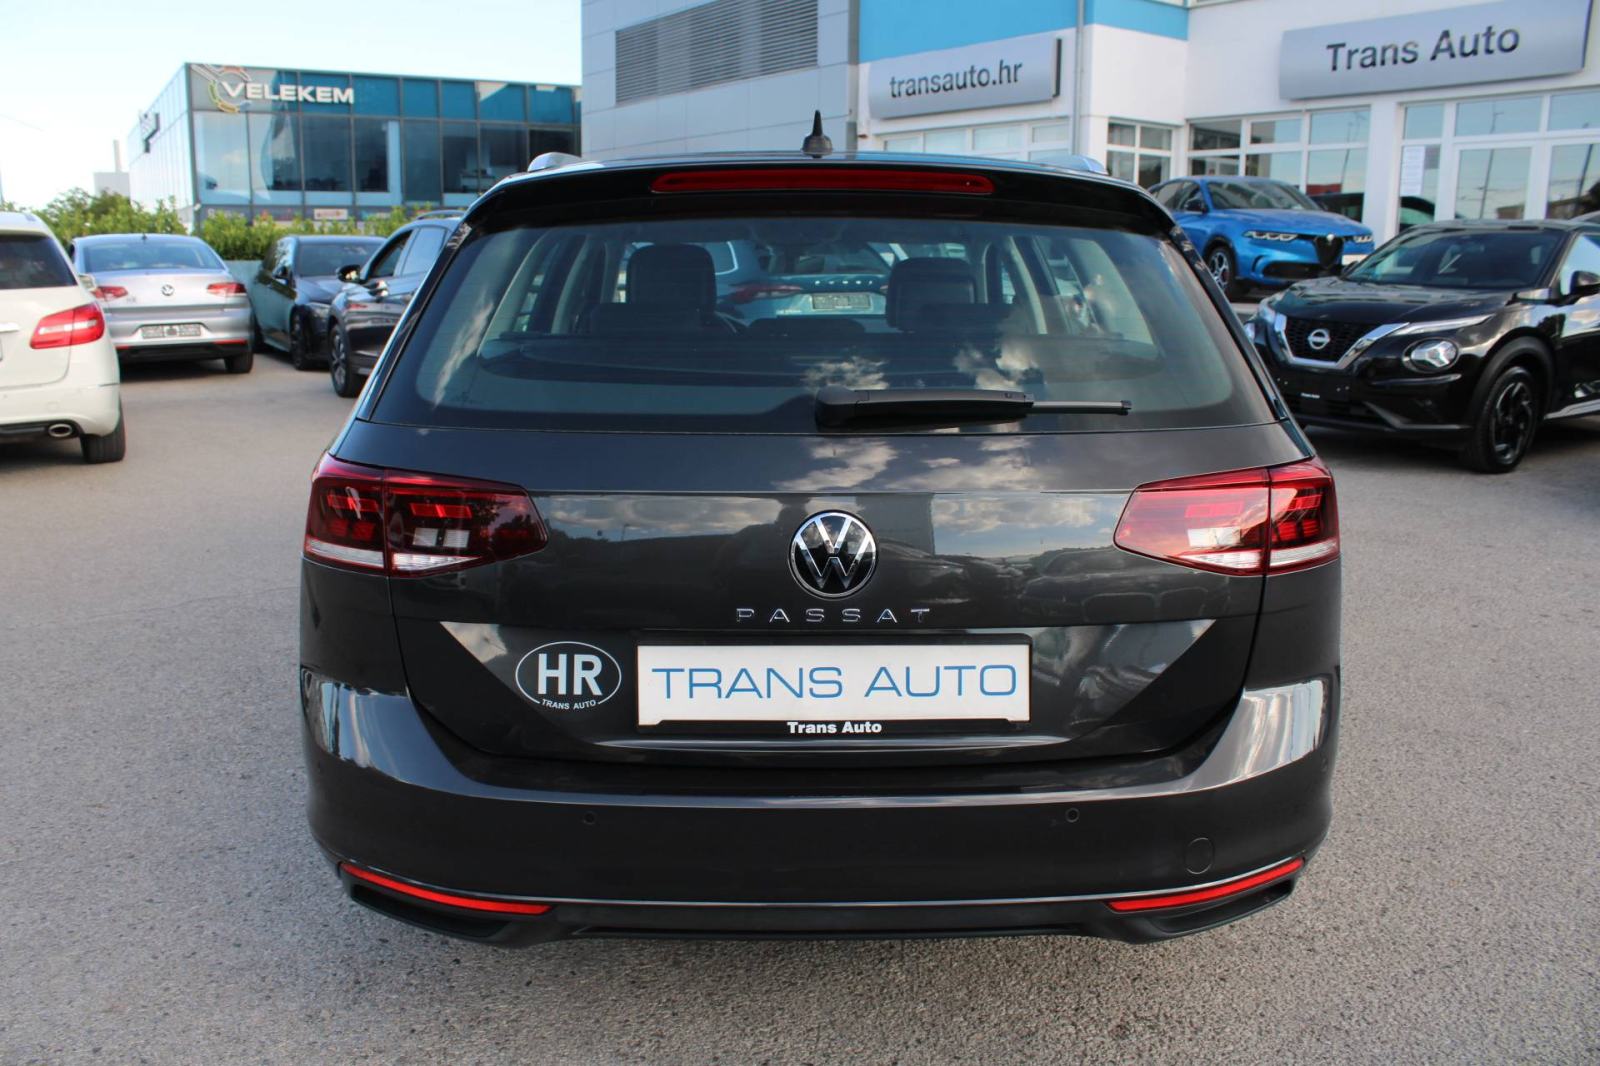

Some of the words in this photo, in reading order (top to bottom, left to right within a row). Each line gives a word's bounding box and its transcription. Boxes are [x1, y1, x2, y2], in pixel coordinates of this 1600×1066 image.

[1326, 41, 1419, 72] Trans
[1430, 25, 1520, 62] Auto
[221, 81, 355, 105] VELEKEM
[889, 59, 1023, 98] transauto.hr
[736, 607, 930, 623] PASSAT
[537, 653, 603, 696] HR
[651, 667, 844, 699] TRANS
[864, 664, 1017, 698] AUTO
[541, 698, 570, 710] TRANS
[573, 699, 597, 710] AUTO
[787, 721, 837, 734] Trans
[841, 721, 882, 734] Auto
